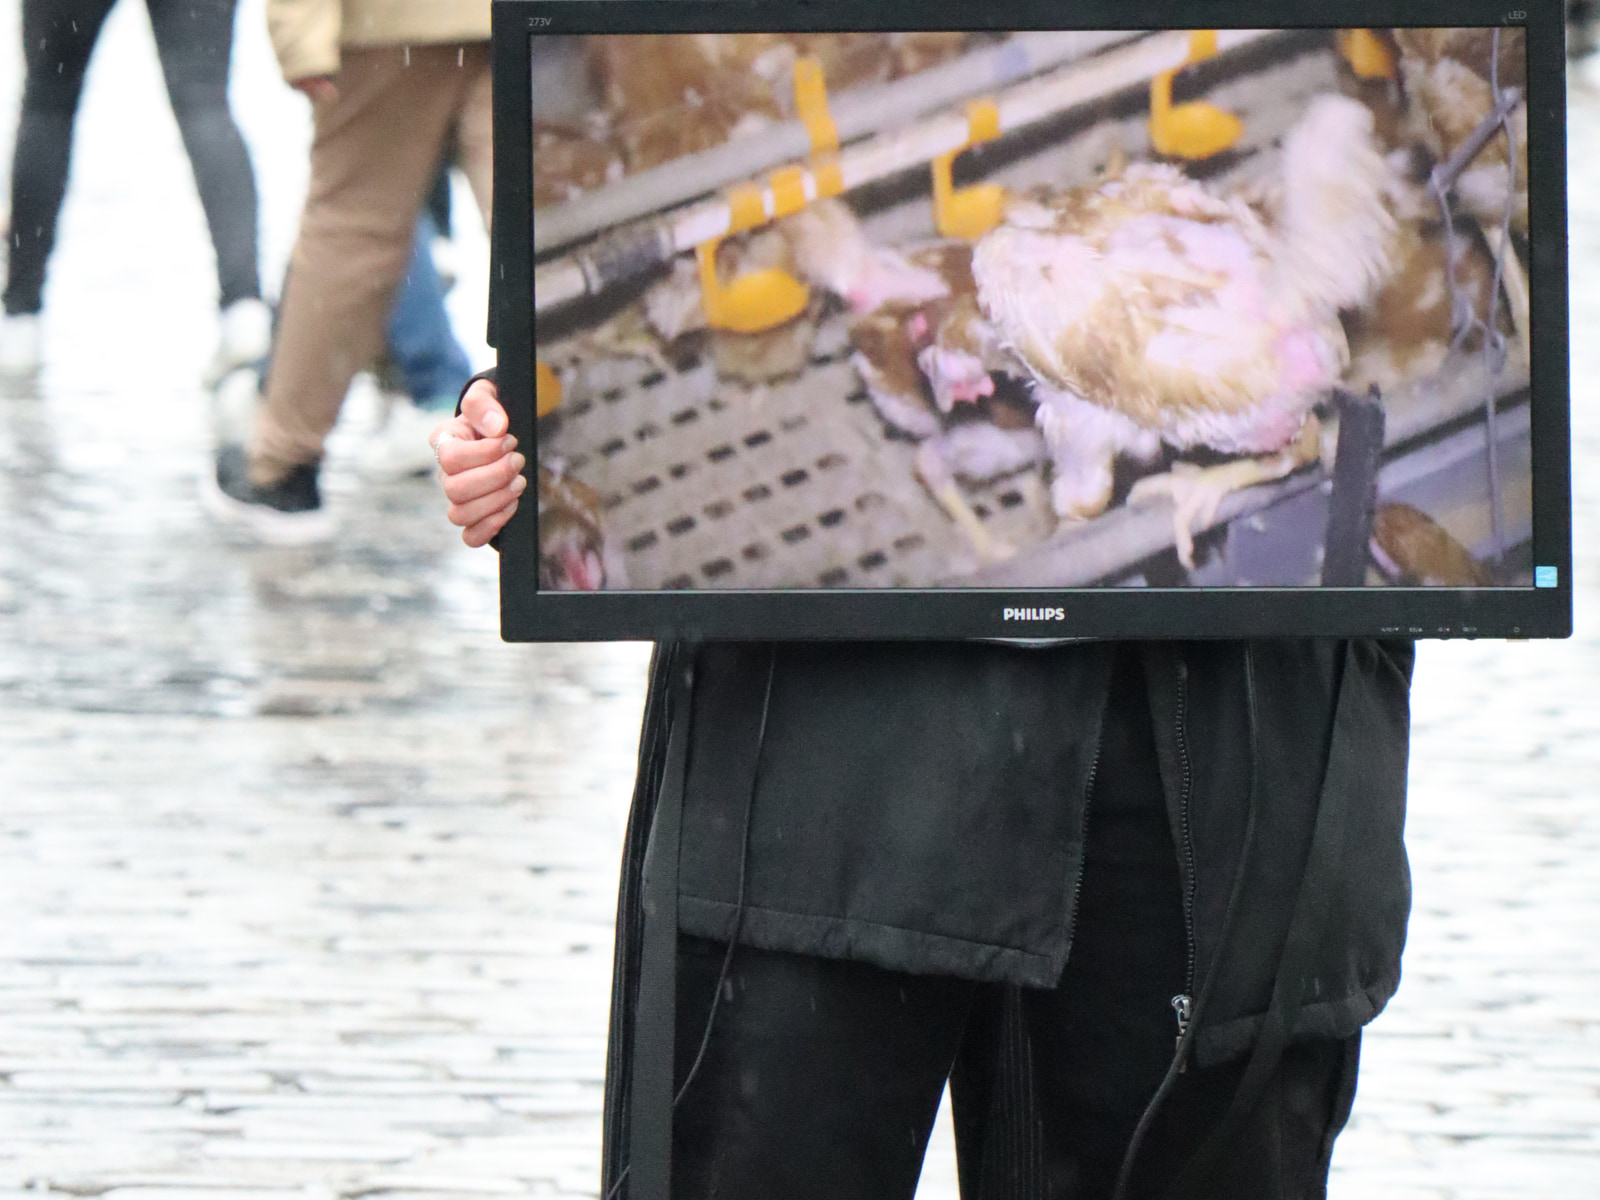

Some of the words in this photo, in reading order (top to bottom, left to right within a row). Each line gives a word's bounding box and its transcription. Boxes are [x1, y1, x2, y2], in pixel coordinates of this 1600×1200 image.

[1508, 10, 1527, 20] LED
[528, 17, 553, 26] 273V
[1003, 608, 1066, 621] PHILIPS
